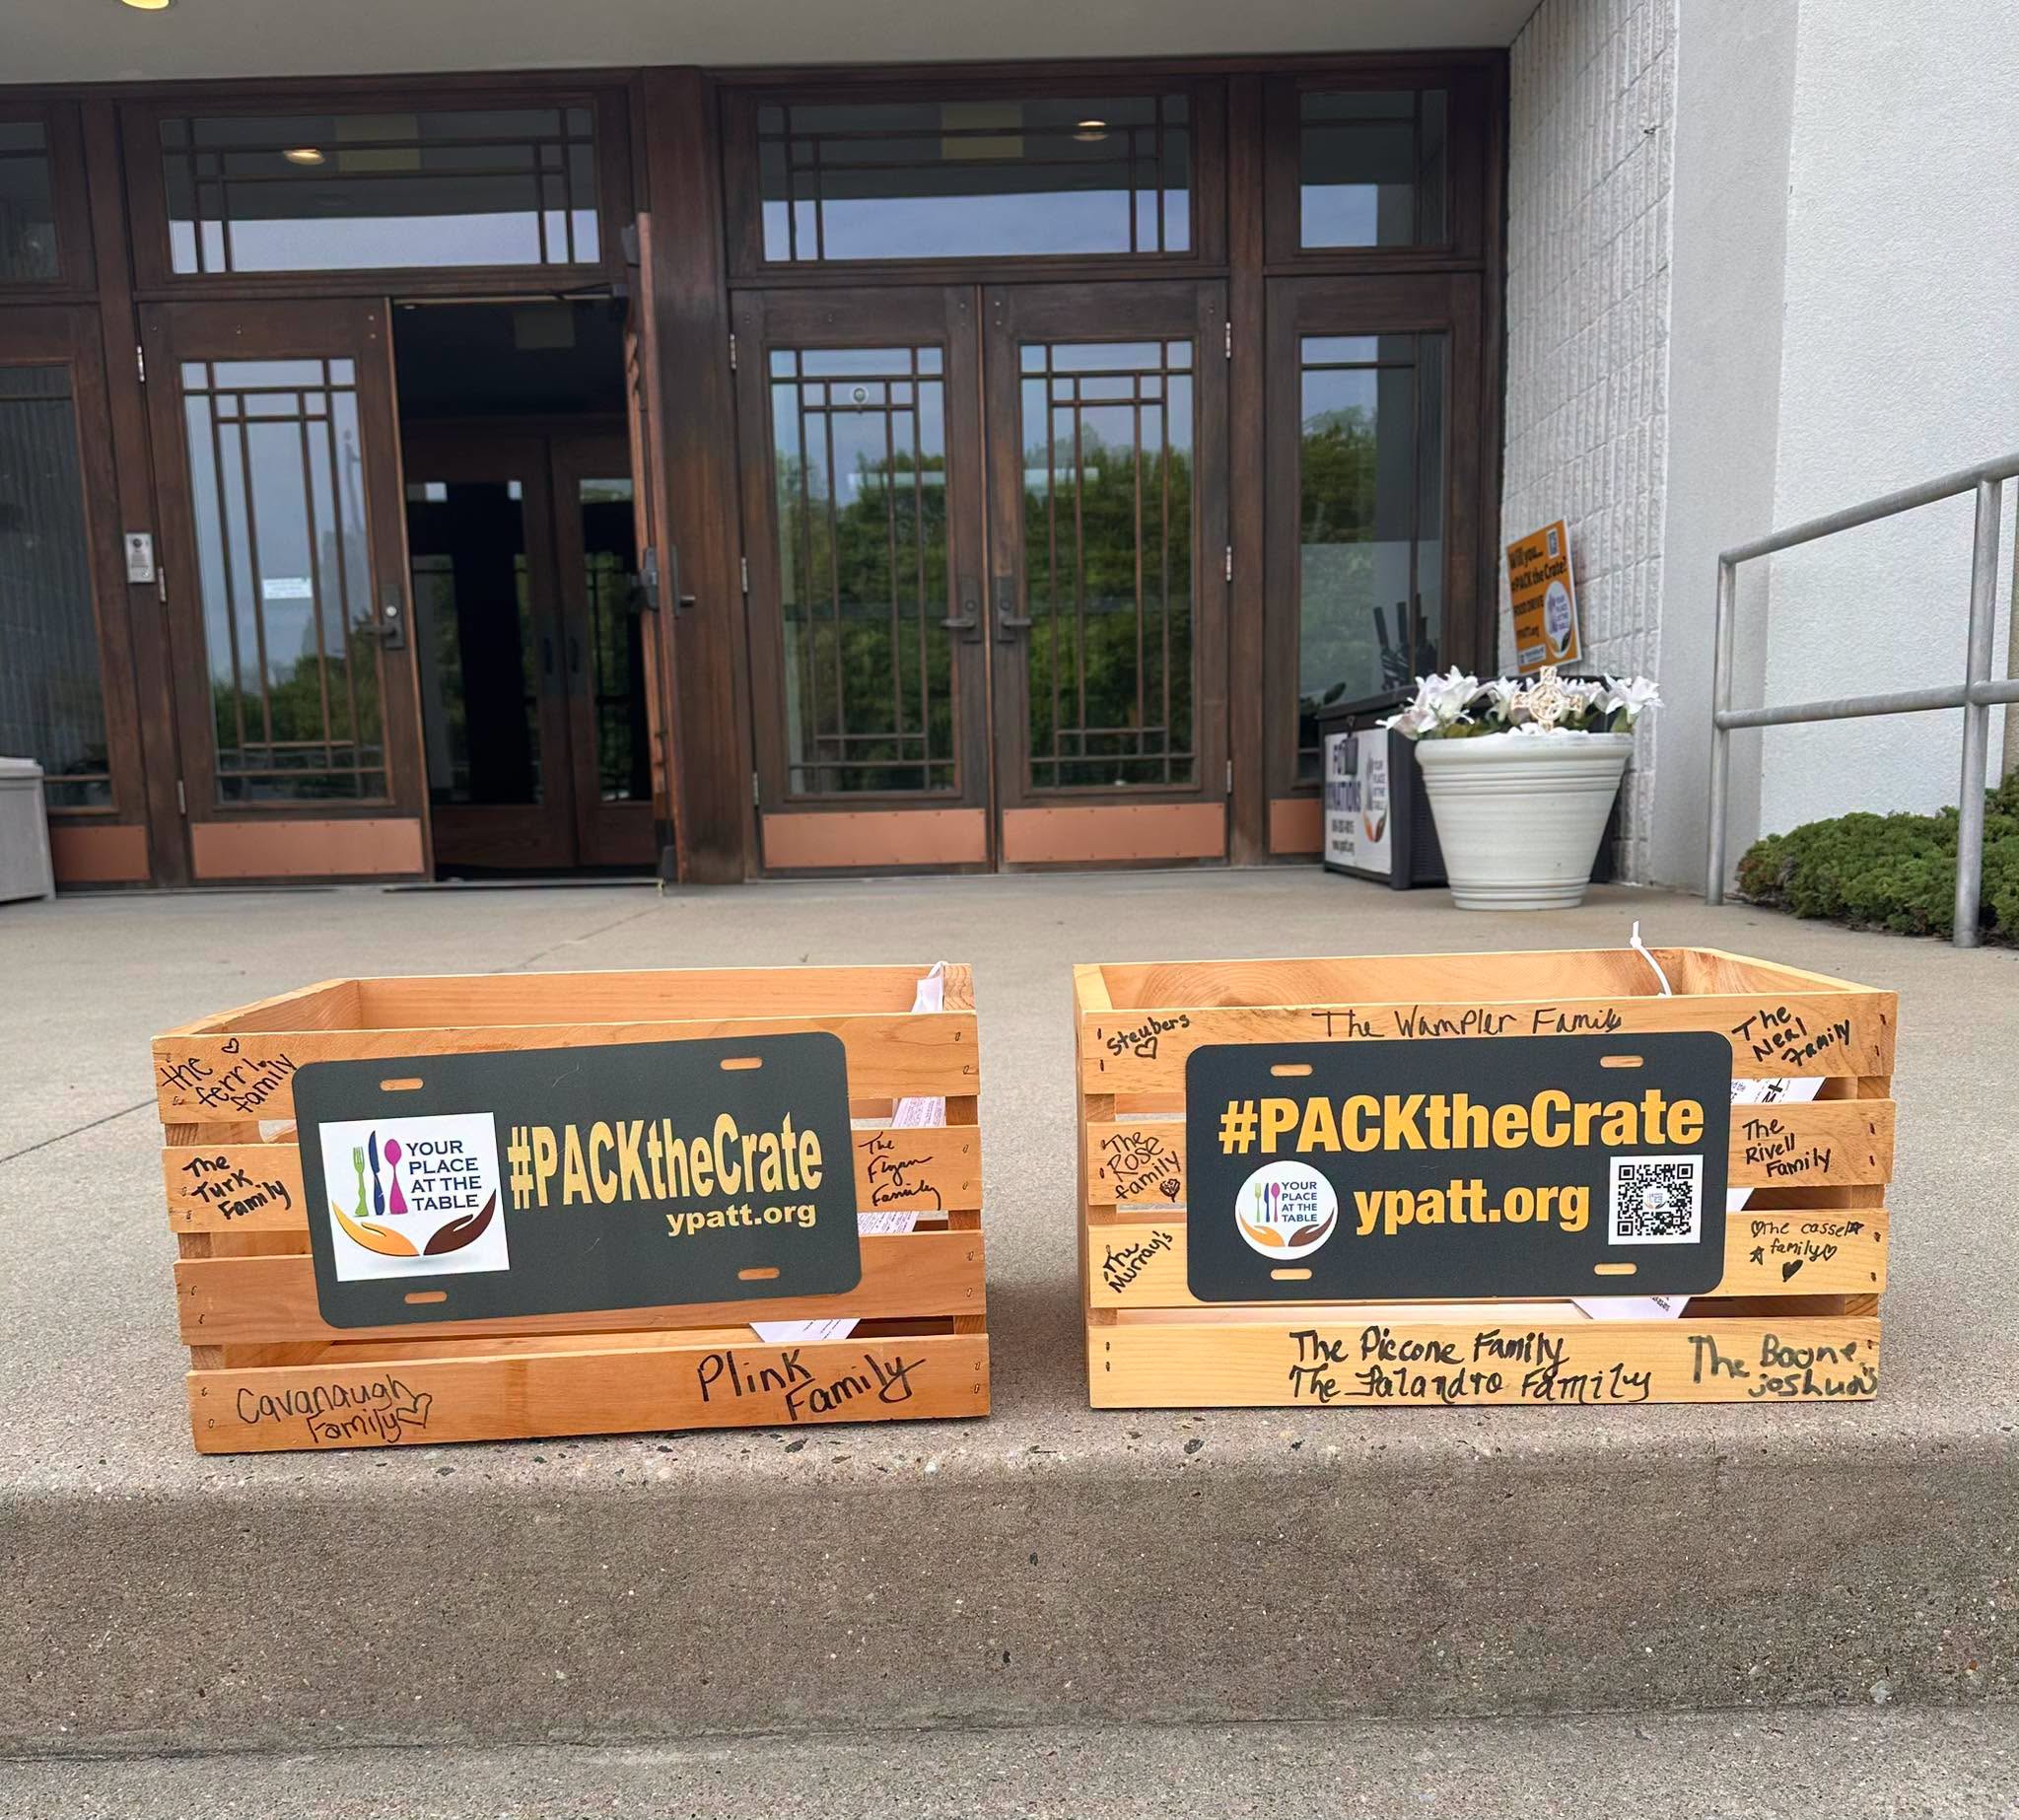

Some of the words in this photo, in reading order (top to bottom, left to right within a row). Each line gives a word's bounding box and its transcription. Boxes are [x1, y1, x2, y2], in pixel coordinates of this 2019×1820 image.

[1311, 1010, 1384, 1037] The
[1731, 1006, 1791, 1041] The
[1753, 1016, 1807, 1062] Neal
[1781, 1018, 1849, 1066] Family
[230, 1053, 298, 1113] family
[1218, 1088, 1705, 1155] #PACKtheCrate
[1742, 1119, 1784, 1141] The
[405, 1139, 464, 1157] YOUR
[858, 1131, 895, 1155] The
[1104, 1132, 1147, 1153] The
[1745, 1133, 1795, 1164] Rivell
[181, 1155, 231, 1177] The
[408, 1156, 479, 1175] PLACE
[507, 1111, 822, 1211] #PACKtheCrate
[1115, 1151, 1181, 1199] family
[1766, 1147, 1831, 1177] Family
[190, 1168, 253, 1203] Turk
[218, 1180, 292, 1220] Family
[410, 1177, 434, 1193] AT
[438, 1174, 482, 1191] THE
[871, 1179, 941, 1212] Family
[1282, 1181, 1317, 1191] YOUR
[1282, 1193, 1318, 1202] PLACE
[410, 1194, 480, 1212] TABLE
[665, 1203, 817, 1236] ypatt.org
[1282, 1204, 1294, 1213] AT
[1297, 1203, 1318, 1213] THE
[1282, 1214, 1318, 1224] TABLE
[1354, 1179, 1589, 1236] ypatt.org
[1102, 1243, 1140, 1274] The
[1108, 1230, 1173, 1294] Murray's
[1771, 1237, 1824, 1262] family
[1289, 1330, 1349, 1363] The
[1474, 1329, 1569, 1378] Family
[1688, 1334, 1750, 1383] The
[696, 1348, 812, 1402] Plink
[785, 1353, 927, 1422] Family
[1289, 1363, 1340, 1403] The
[1522, 1363, 1651, 1404] Family
[237, 1373, 416, 1424] Cavanaugh
[306, 1409, 402, 1443] Family
